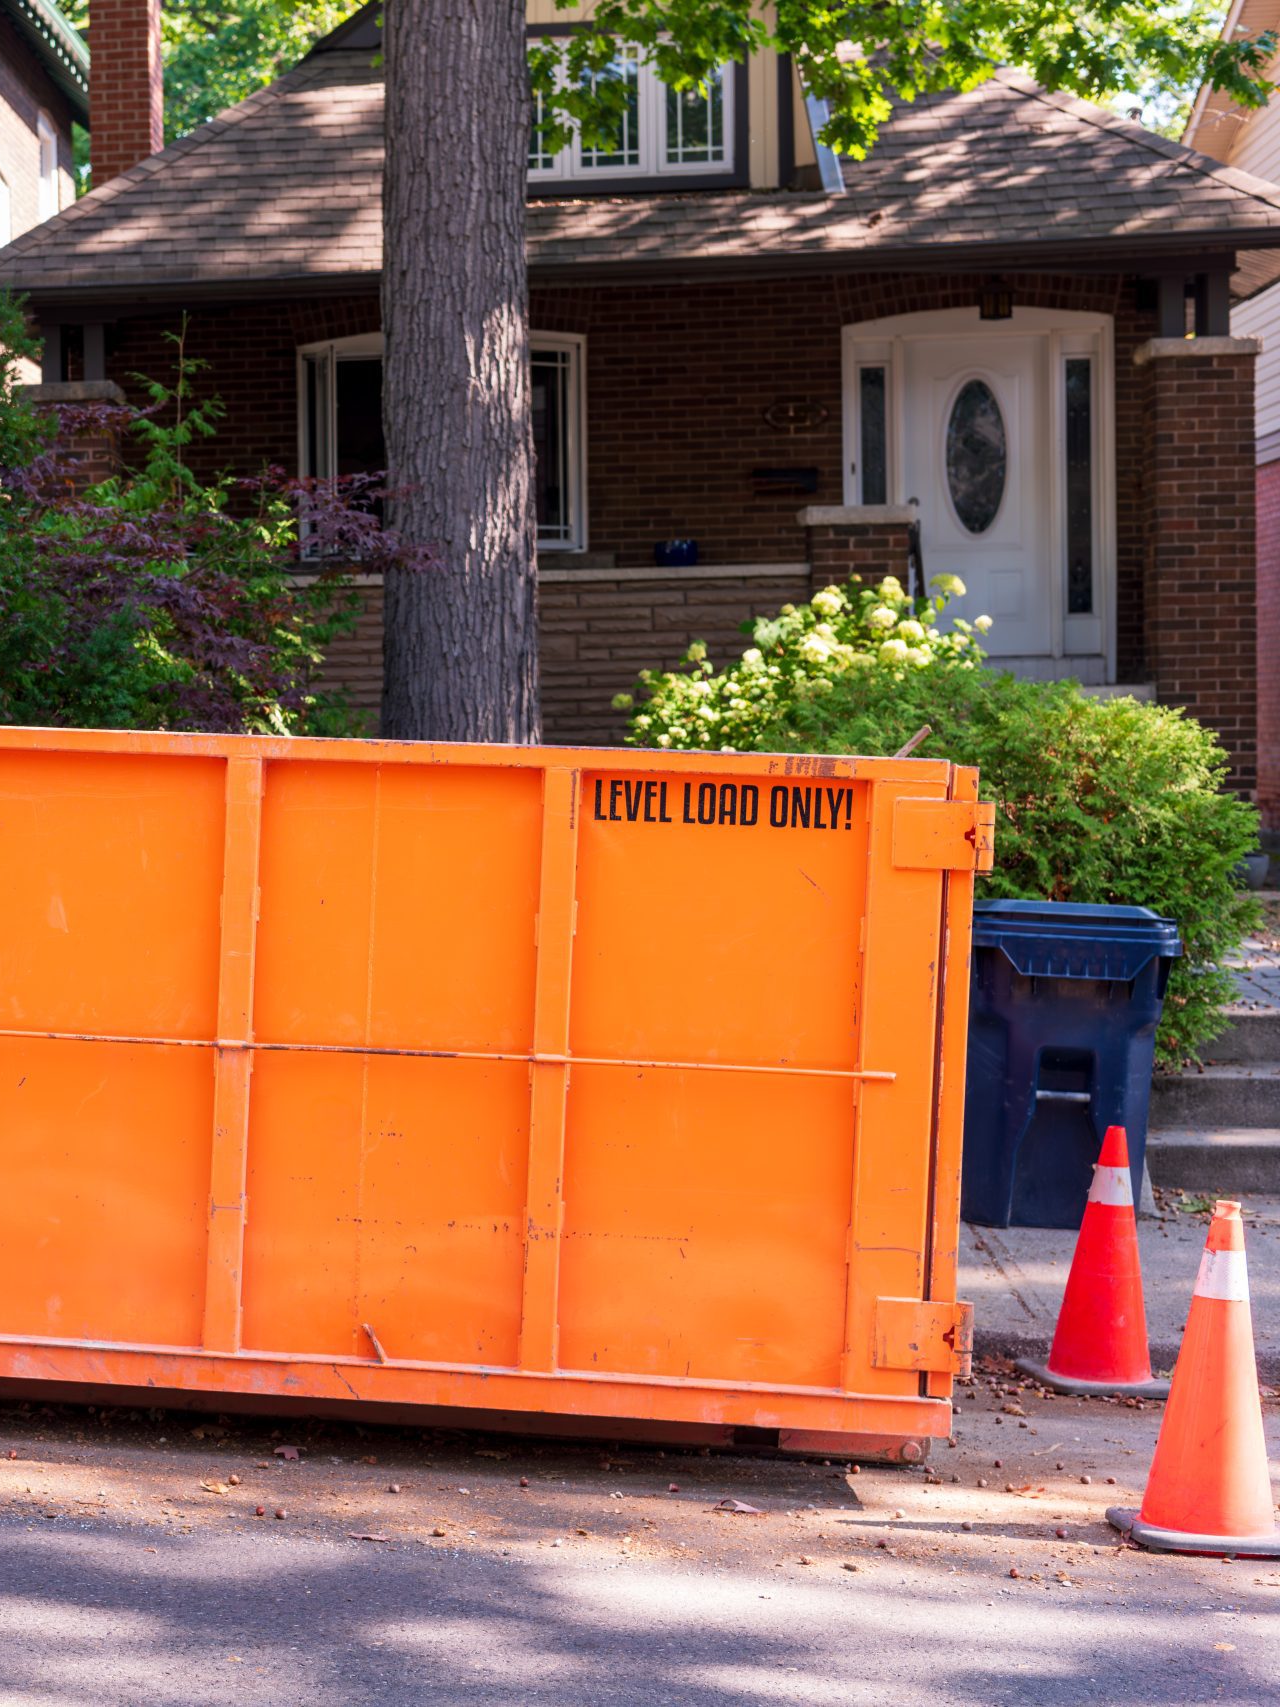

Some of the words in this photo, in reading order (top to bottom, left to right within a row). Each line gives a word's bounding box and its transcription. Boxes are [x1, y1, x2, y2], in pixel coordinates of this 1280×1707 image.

[594, 779, 672, 823] LEVEL
[682, 782, 759, 826] LOAD
[770, 785, 853, 830] ONLY!
